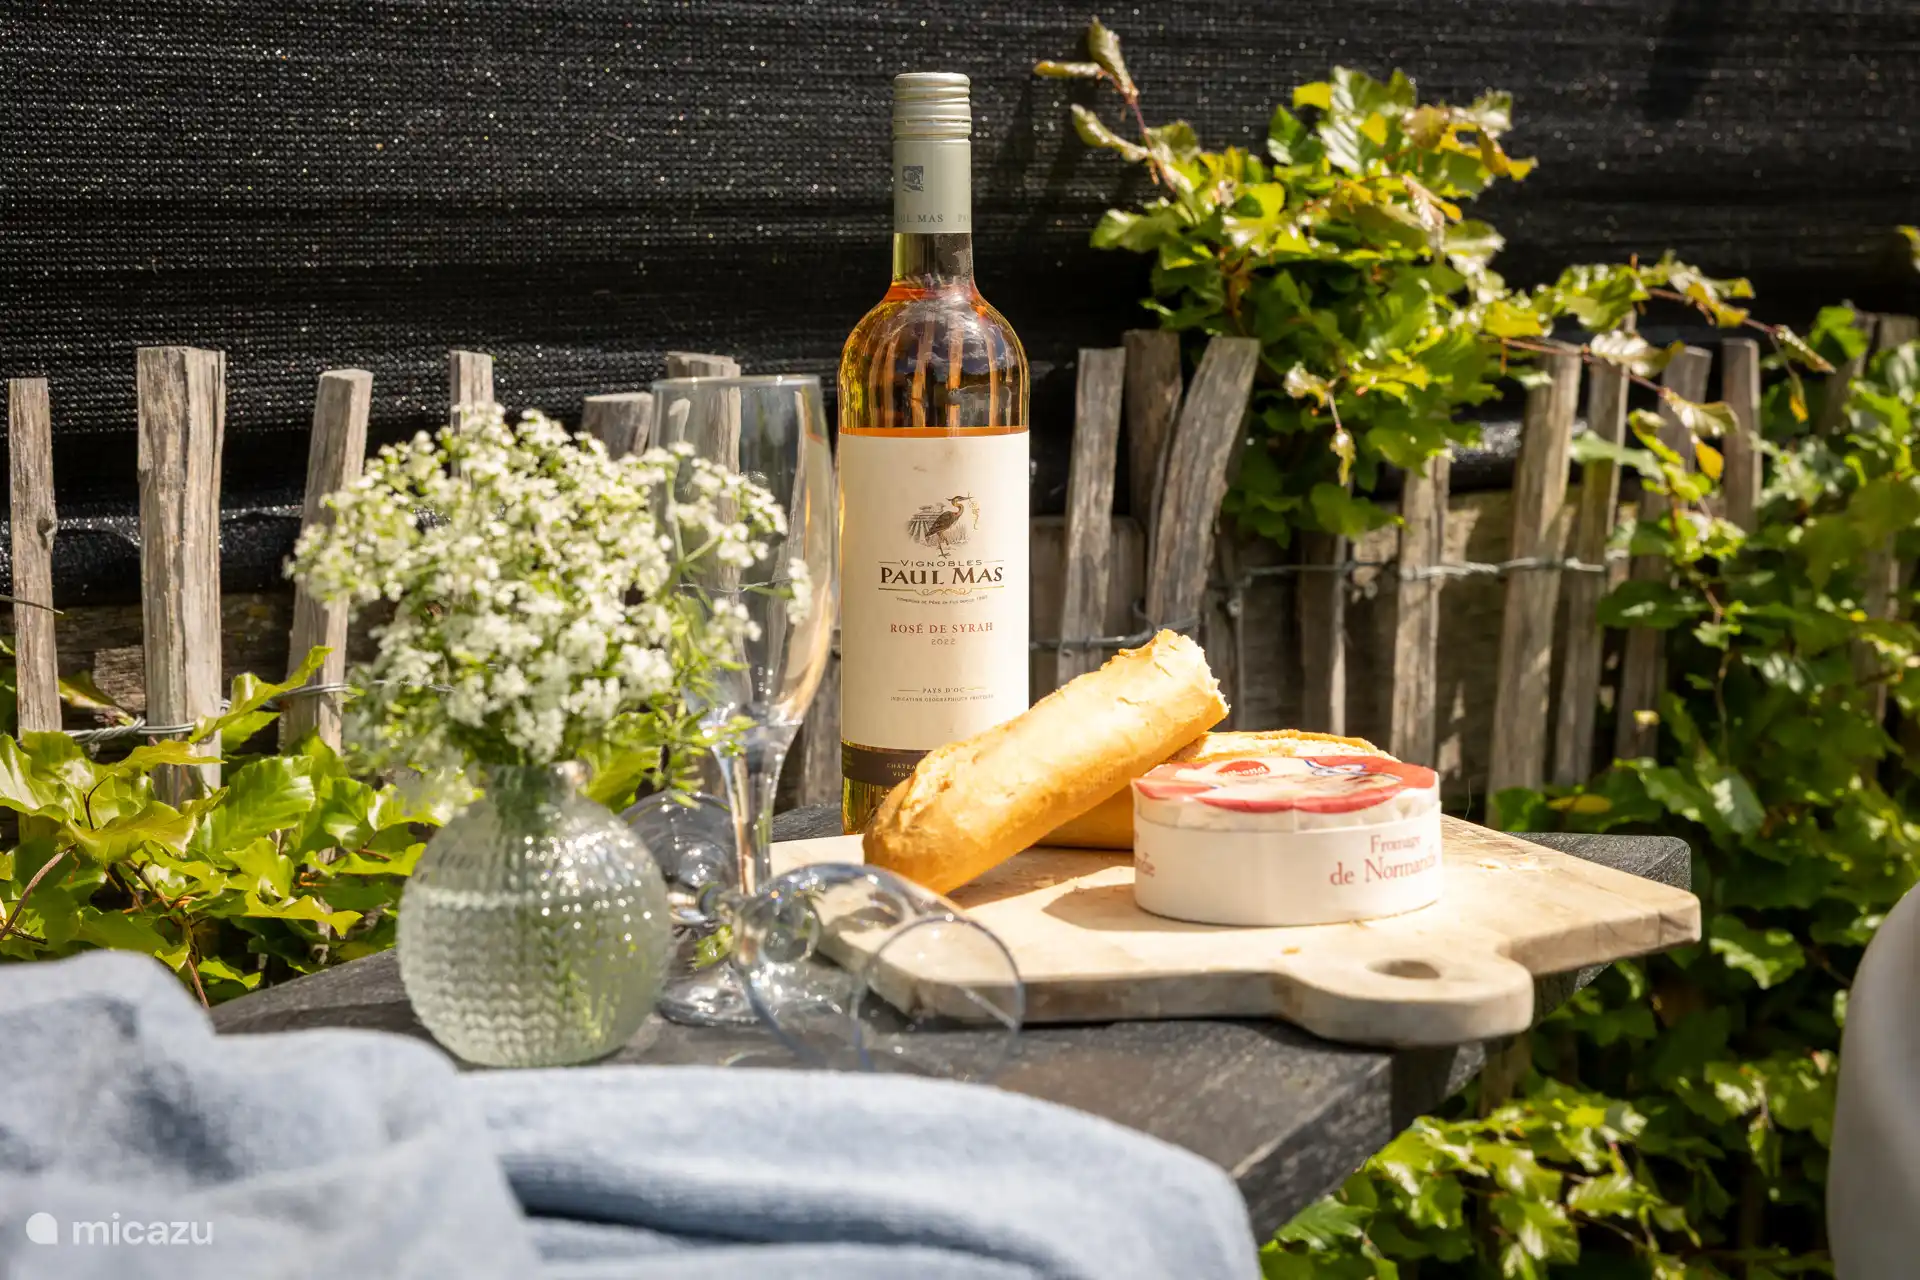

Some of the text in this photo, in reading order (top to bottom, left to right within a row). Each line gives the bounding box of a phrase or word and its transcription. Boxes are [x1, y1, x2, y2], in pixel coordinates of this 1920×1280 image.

[917, 213, 944, 223] MAS
[900, 559, 983, 567] VIGNOBLES
[880, 566, 1003, 585] PAUL MAS
[890, 622, 993, 634] ROSÉ DE SYRAH
[931, 638, 956, 646] 2022
[886, 761, 916, 770] CHÂTEA
[1329, 860, 1355, 886] de
